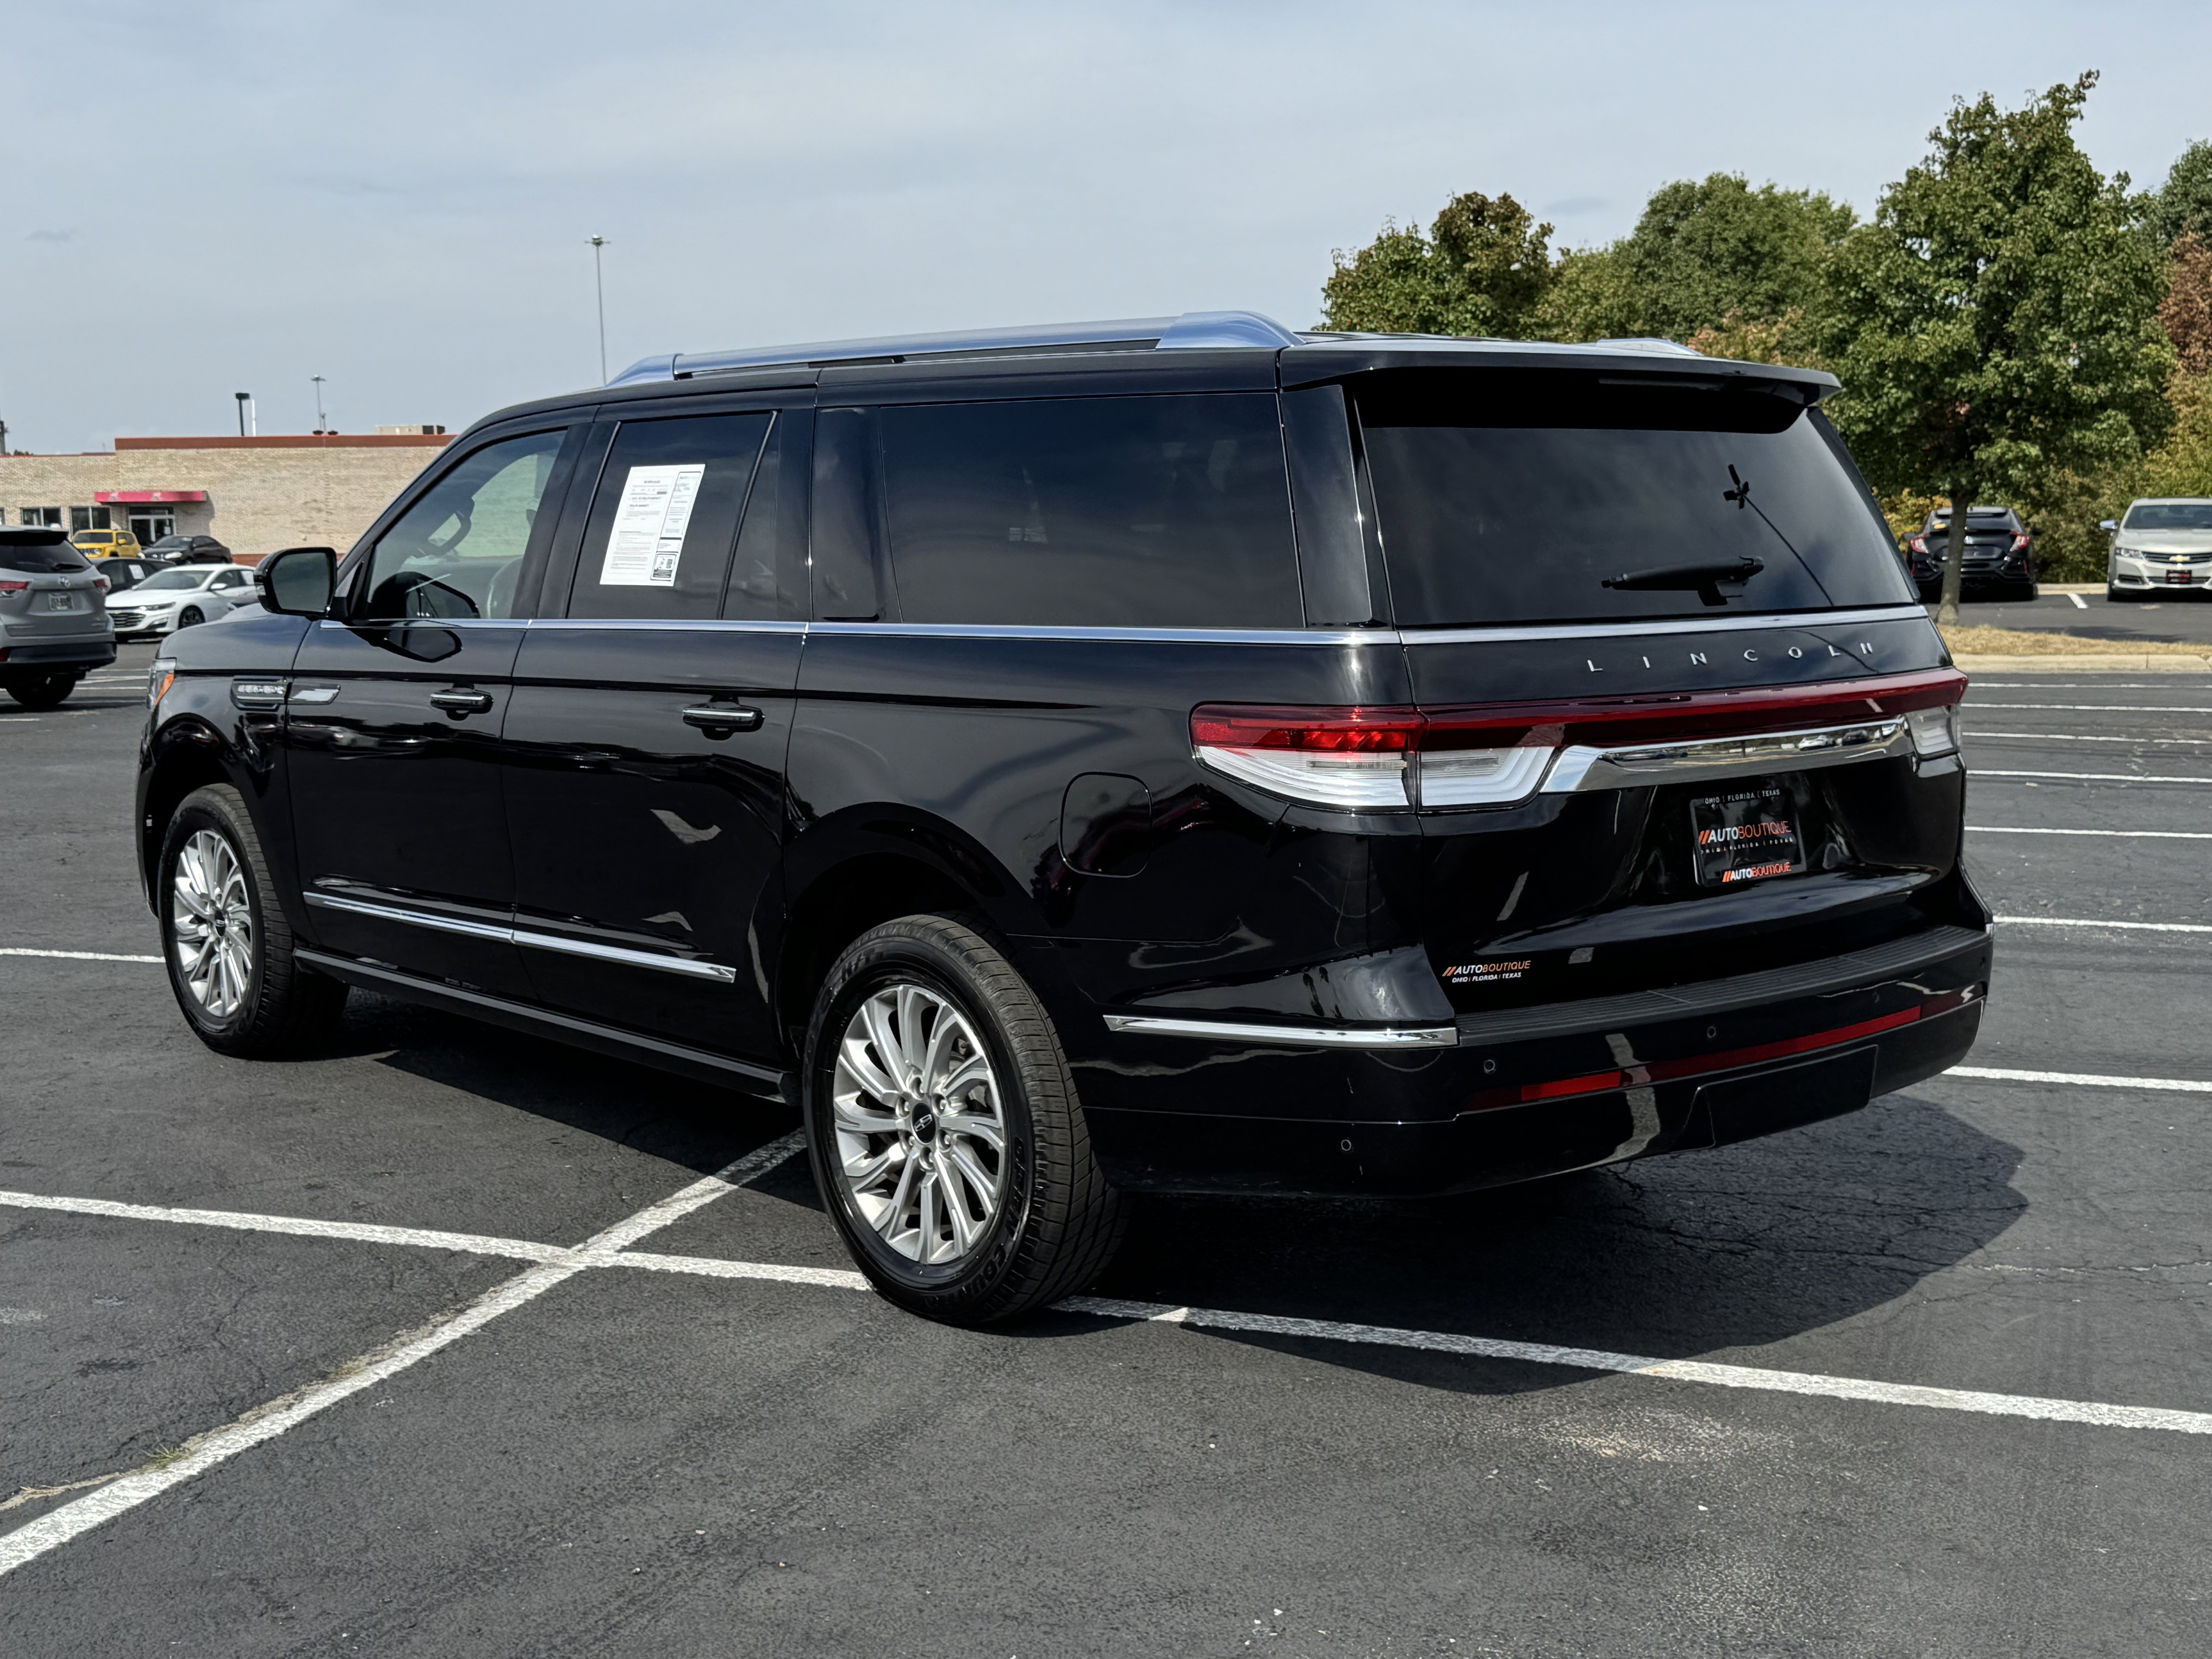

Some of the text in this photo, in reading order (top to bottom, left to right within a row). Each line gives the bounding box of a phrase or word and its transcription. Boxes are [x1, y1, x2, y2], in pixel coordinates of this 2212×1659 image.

[1587, 642, 1873, 672] LINCOLN
[1727, 792, 1756, 801] FLORIDA
[1707, 821, 1792, 843] AUTOBOUTIQUE
[1730, 862, 1792, 881] AUTOBOUTIQUE
[1454, 960, 1531, 975] AUTOBOUTIQUE
